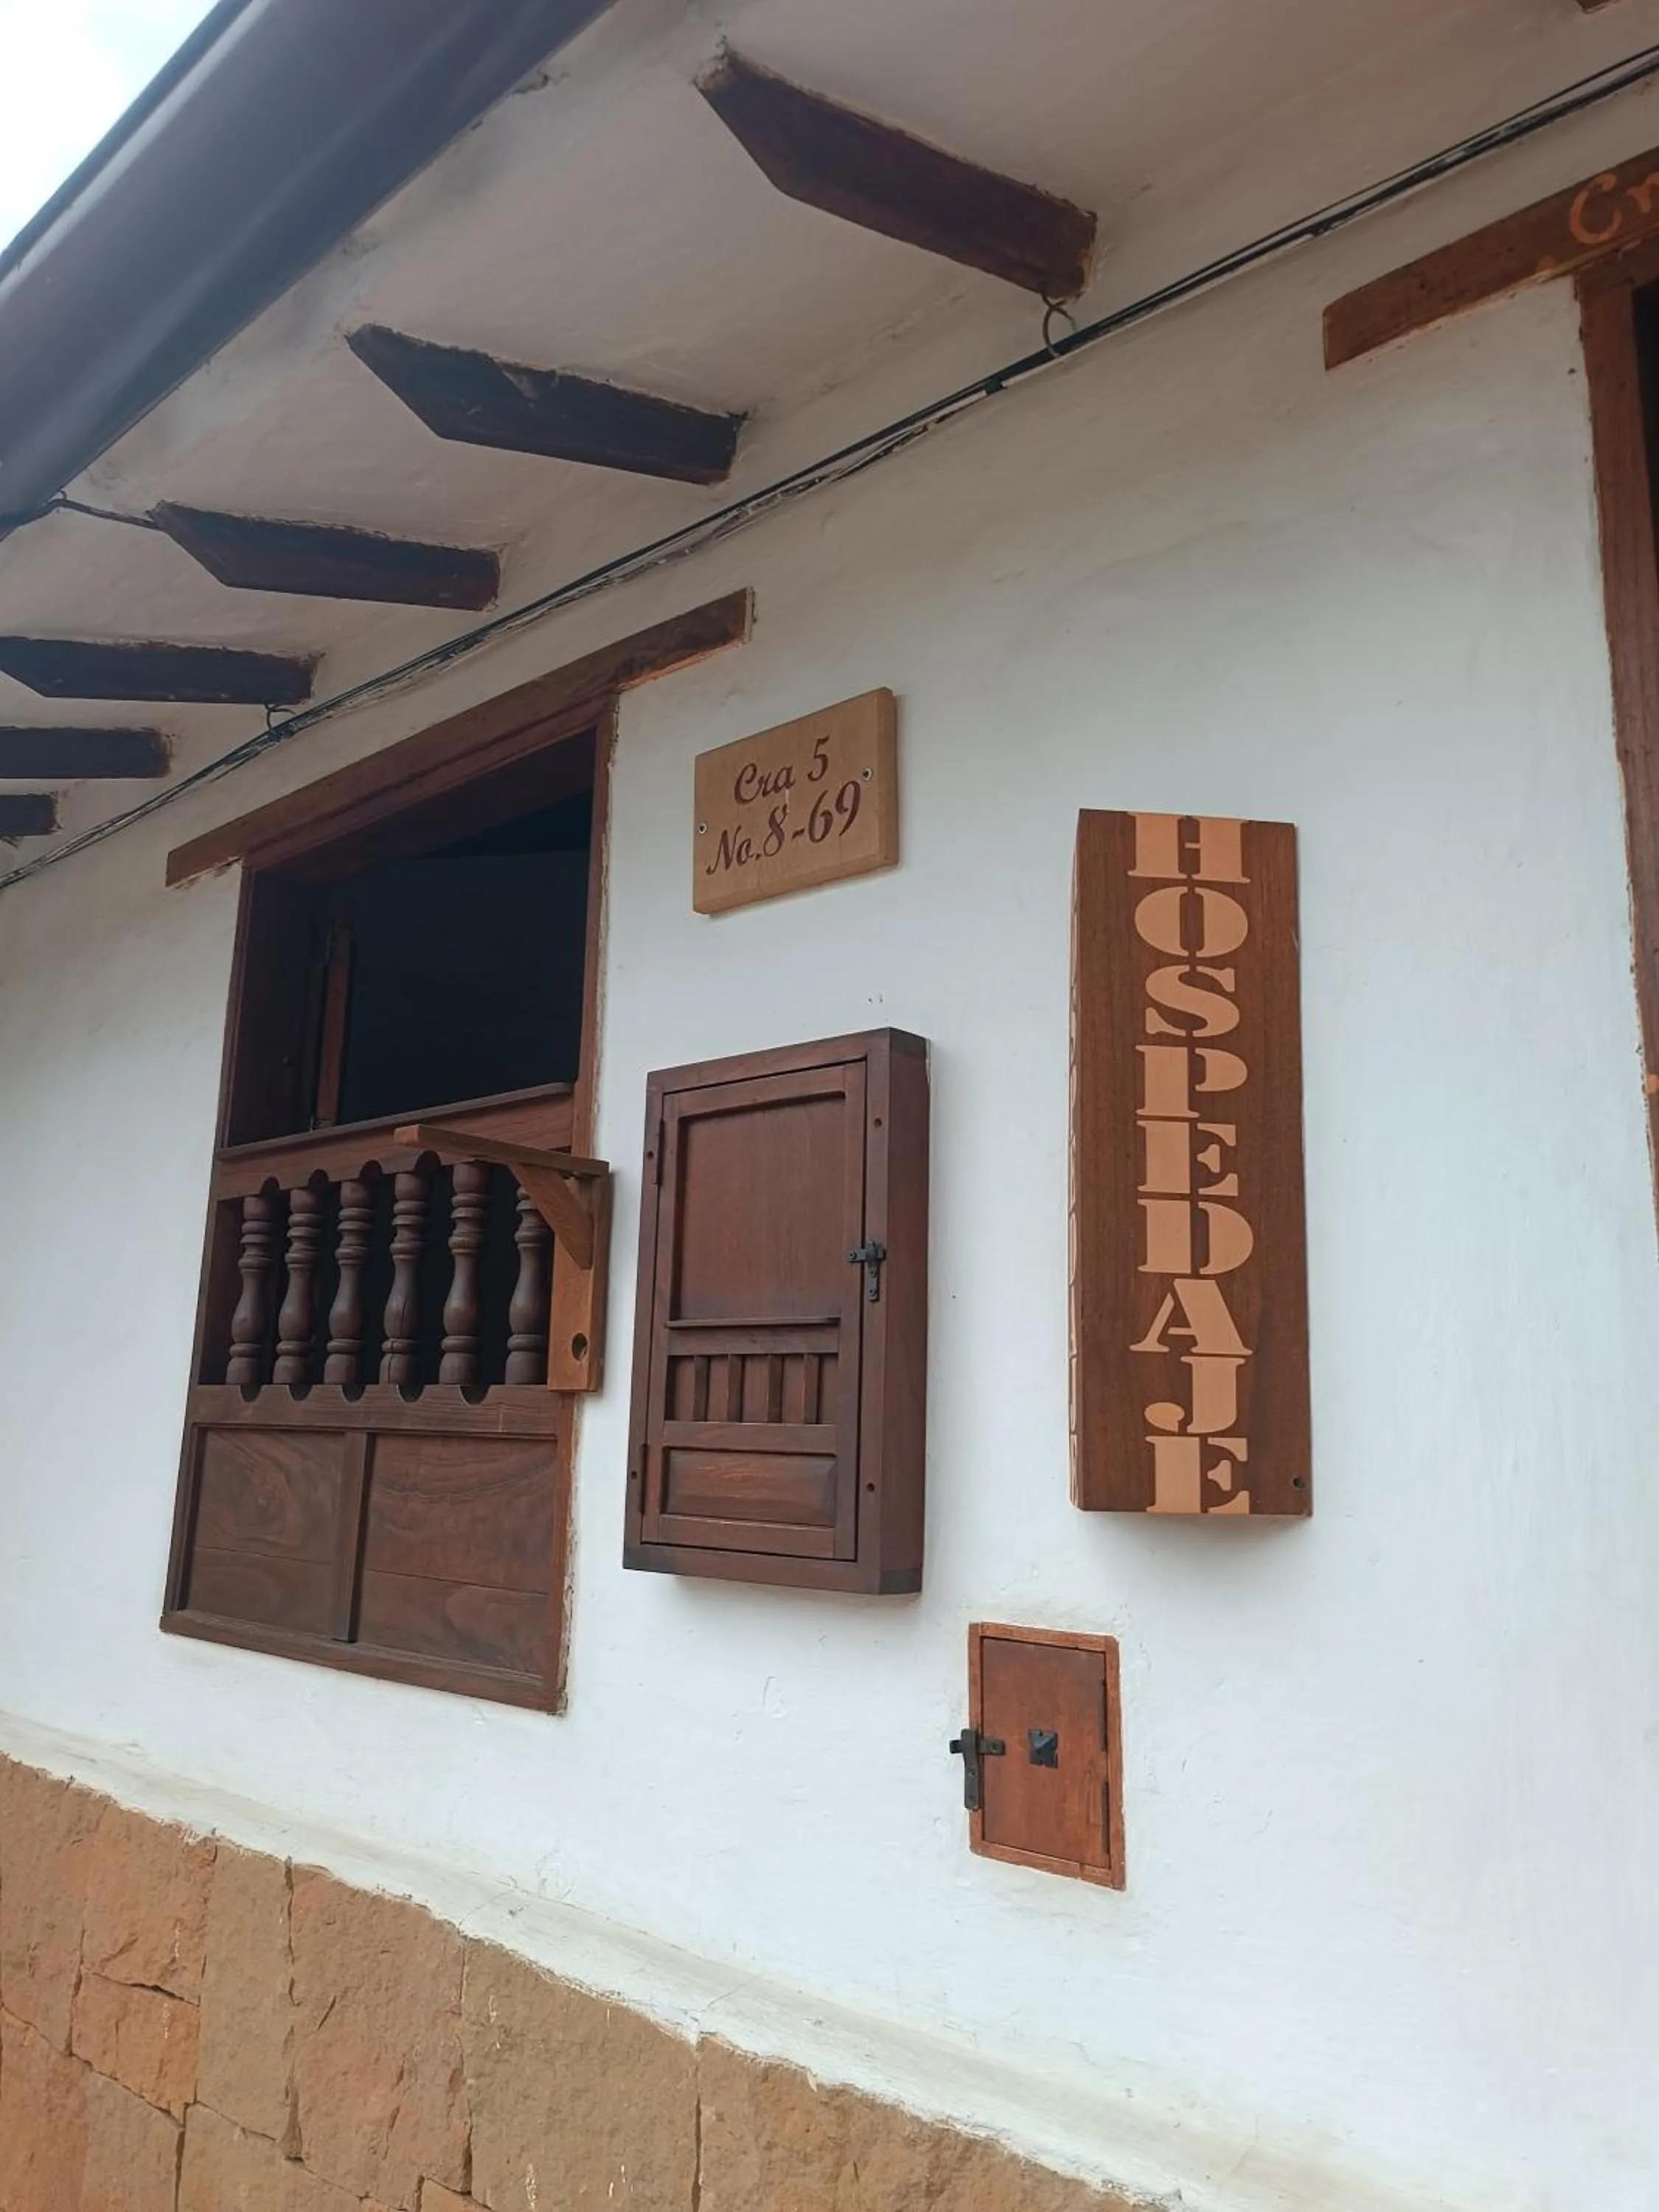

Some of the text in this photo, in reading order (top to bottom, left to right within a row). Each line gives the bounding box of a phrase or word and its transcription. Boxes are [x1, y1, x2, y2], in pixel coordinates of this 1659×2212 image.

[734, 734, 830, 804] Cra 5
[1127, 812, 1255, 1515] HOSPEDAJE
